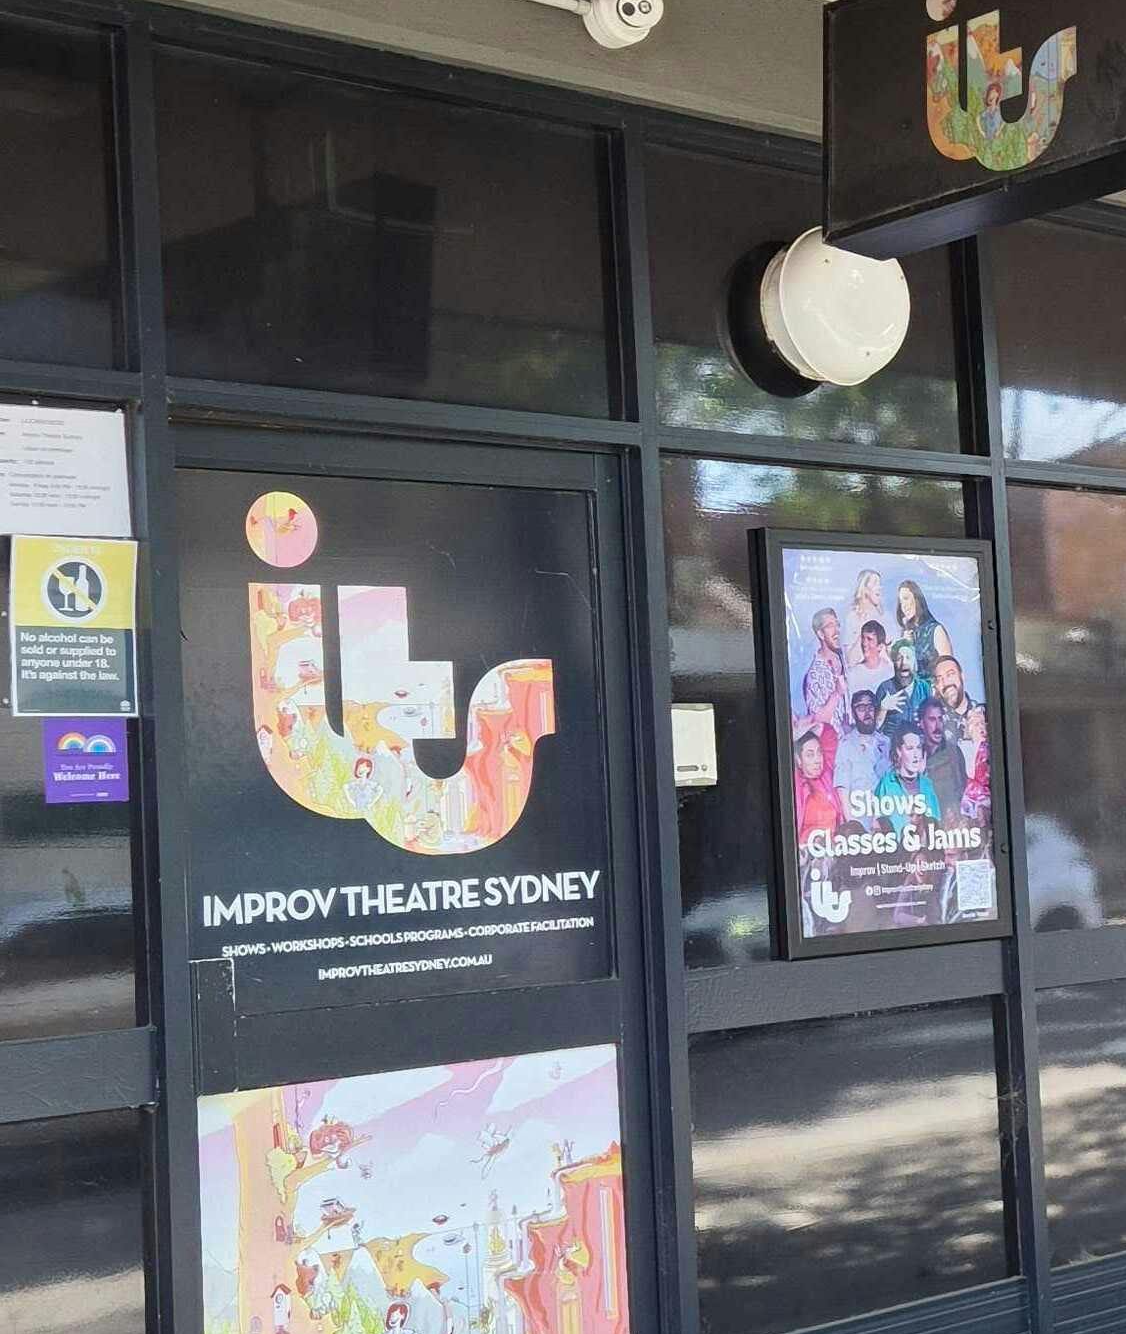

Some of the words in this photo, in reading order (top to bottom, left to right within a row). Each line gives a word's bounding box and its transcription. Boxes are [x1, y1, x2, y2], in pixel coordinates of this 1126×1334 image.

[20, 632, 37, 642] No
[38, 633, 77, 643] alcohol
[78, 635, 98, 643] can
[100, 634, 114, 644] be
[20, 644, 43, 655] sold
[46, 646, 59, 655] or
[59, 646, 103, 657] supplied
[105, 647, 117, 656] to
[21, 659, 61, 668] anyone
[62, 658, 93, 668] under
[95, 659, 110, 668] 18.
[21, 669, 37, 679] It's
[39, 670, 77, 681] against
[79, 670, 97, 680] the
[98, 670, 120, 681] law.
[53, 771, 96, 781] Welcome
[850, 789, 933, 817] Shows,
[807, 829, 898, 858] Classes
[903, 823, 922, 852] &
[928, 823, 982, 851] Jams
[850, 865, 876, 878] Improv
[881, 862, 916, 876] Stand-Up
[203, 888, 337, 927] IMPROV
[340, 879, 481, 917] THEATRE
[484, 870, 600, 906] SYDNEY
[222, 942, 266, 958] SHOWS
[270, 936, 345, 953] WORKSHOPS
[349, 931, 404, 948] SCHOOLS
[404, 927, 464, 943] PROGRAMS
[468, 921, 531, 937] CORPORATE
[531, 916, 595, 932] FACILITATION
[318, 953, 493, 981] IMPROVTHEATRESYDNEY.COM.AU
